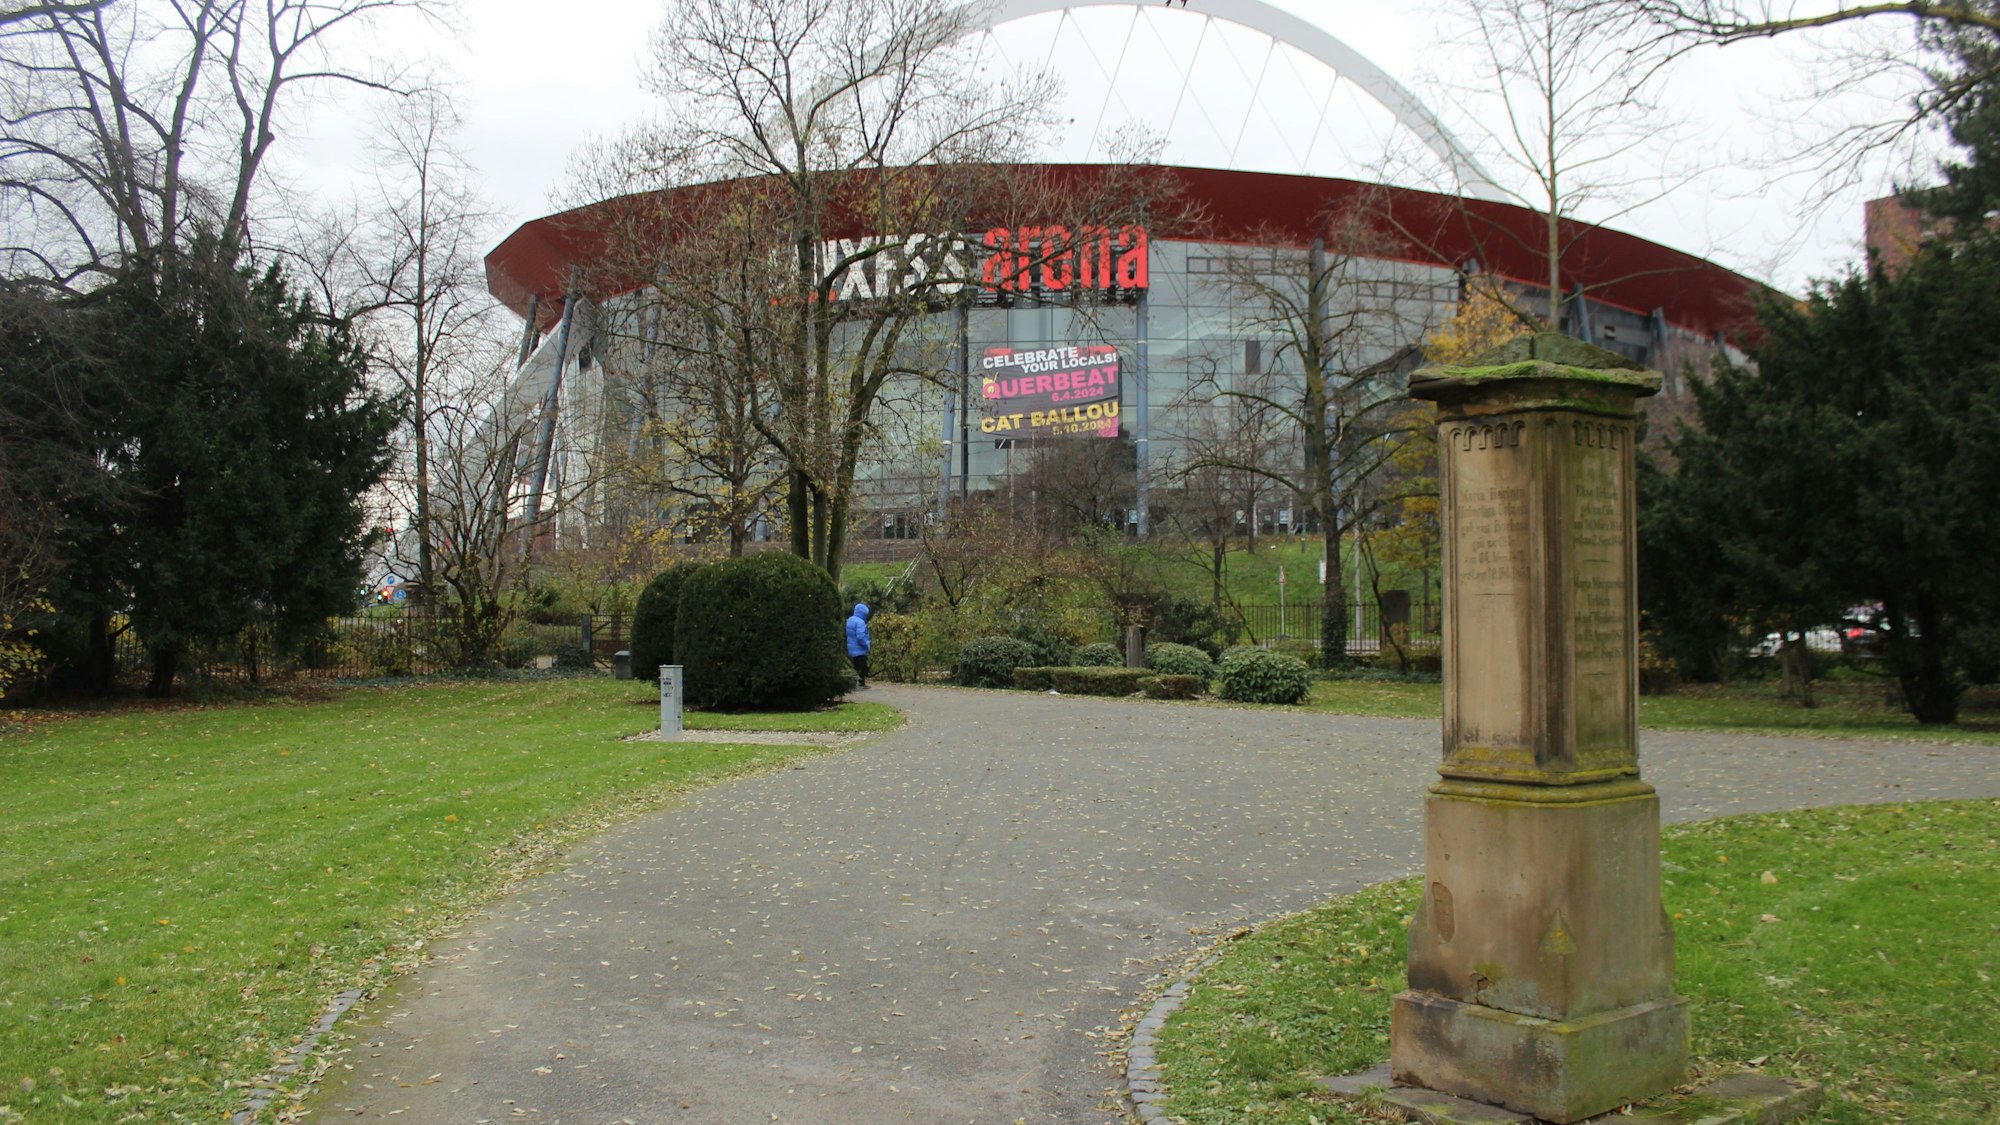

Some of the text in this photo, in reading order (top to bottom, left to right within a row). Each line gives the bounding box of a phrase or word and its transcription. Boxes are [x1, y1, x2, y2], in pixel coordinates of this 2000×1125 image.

[766, 224, 1150, 302] NXESS arena
[983, 346, 1079, 369] CELEBRATE
[1021, 352, 1117, 374] YOUR LOCALS!
[983, 365, 1119, 400] QUERBEAT
[1051, 386, 1105, 402] 6.4.2024
[981, 401, 1119, 433] CAT BALLOU
